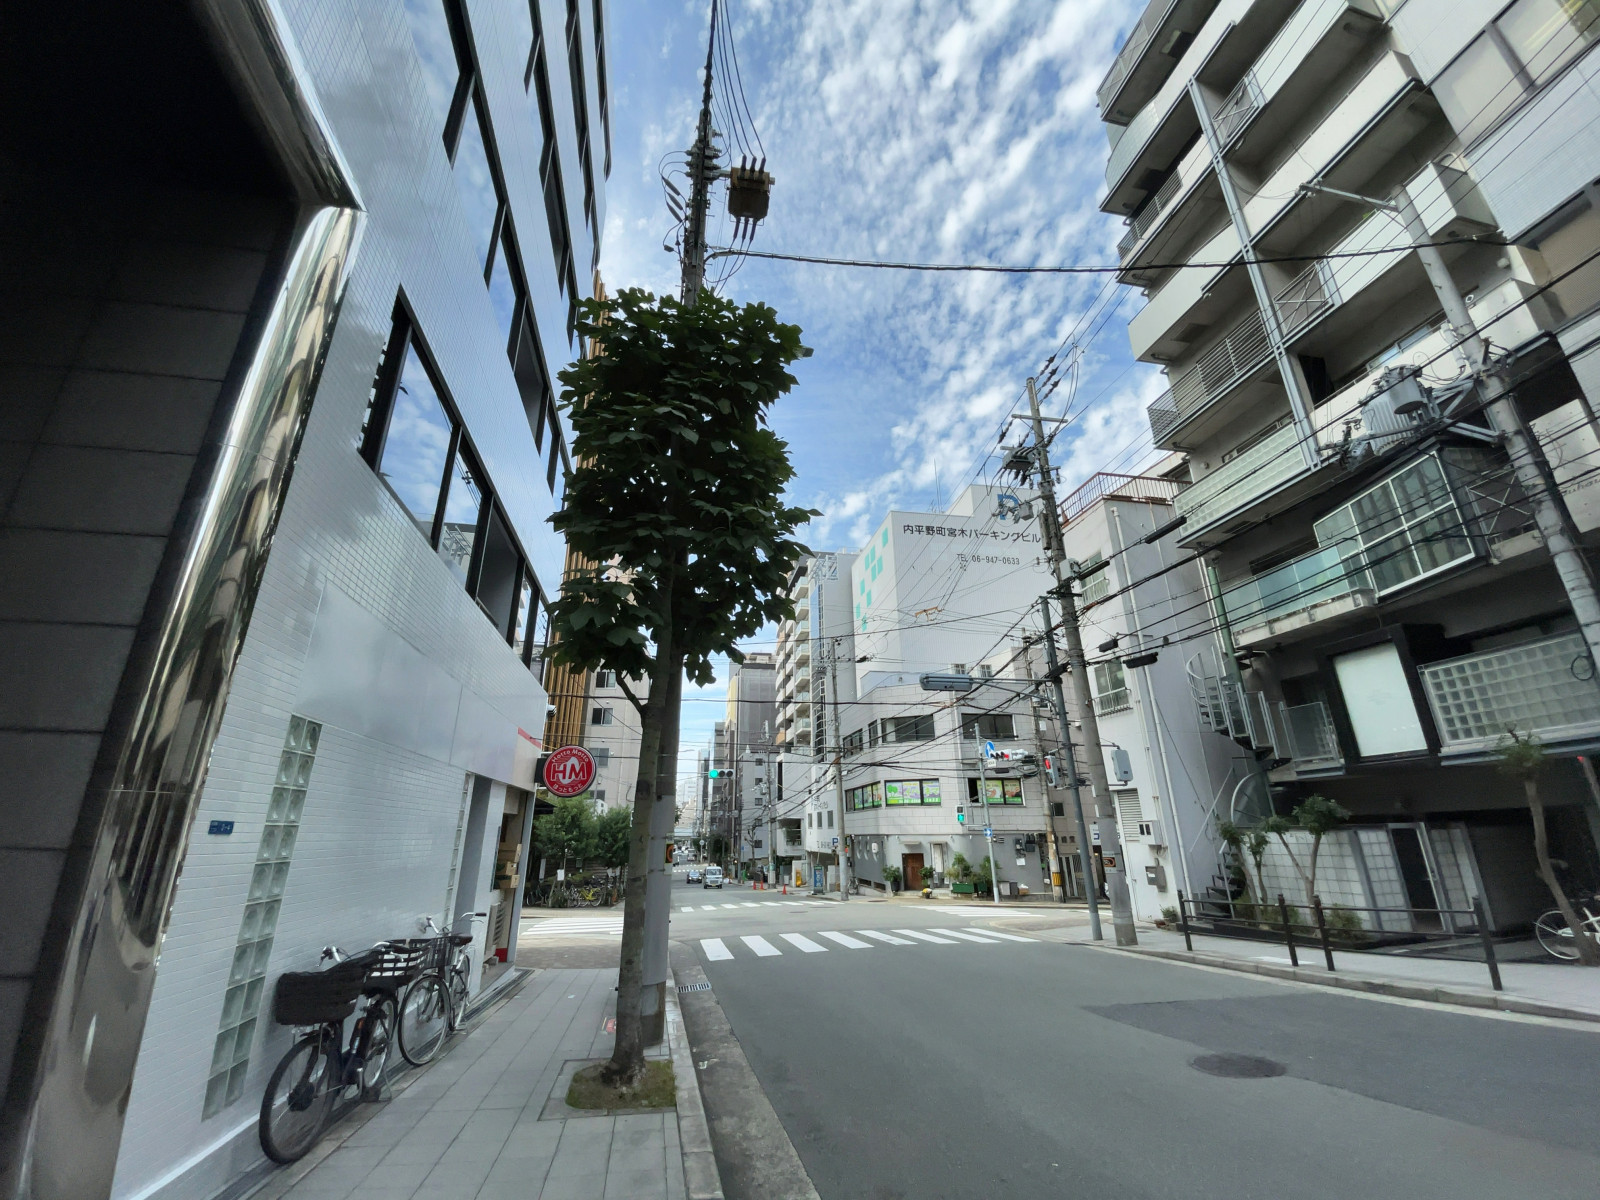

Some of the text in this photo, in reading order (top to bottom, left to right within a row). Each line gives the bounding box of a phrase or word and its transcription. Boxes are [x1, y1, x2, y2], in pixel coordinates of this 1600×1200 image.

[957, 553, 1020, 565] TEL 06-947-0633
[552, 749, 588, 762] Hotto Motto
[832, 838, 838, 846] P
